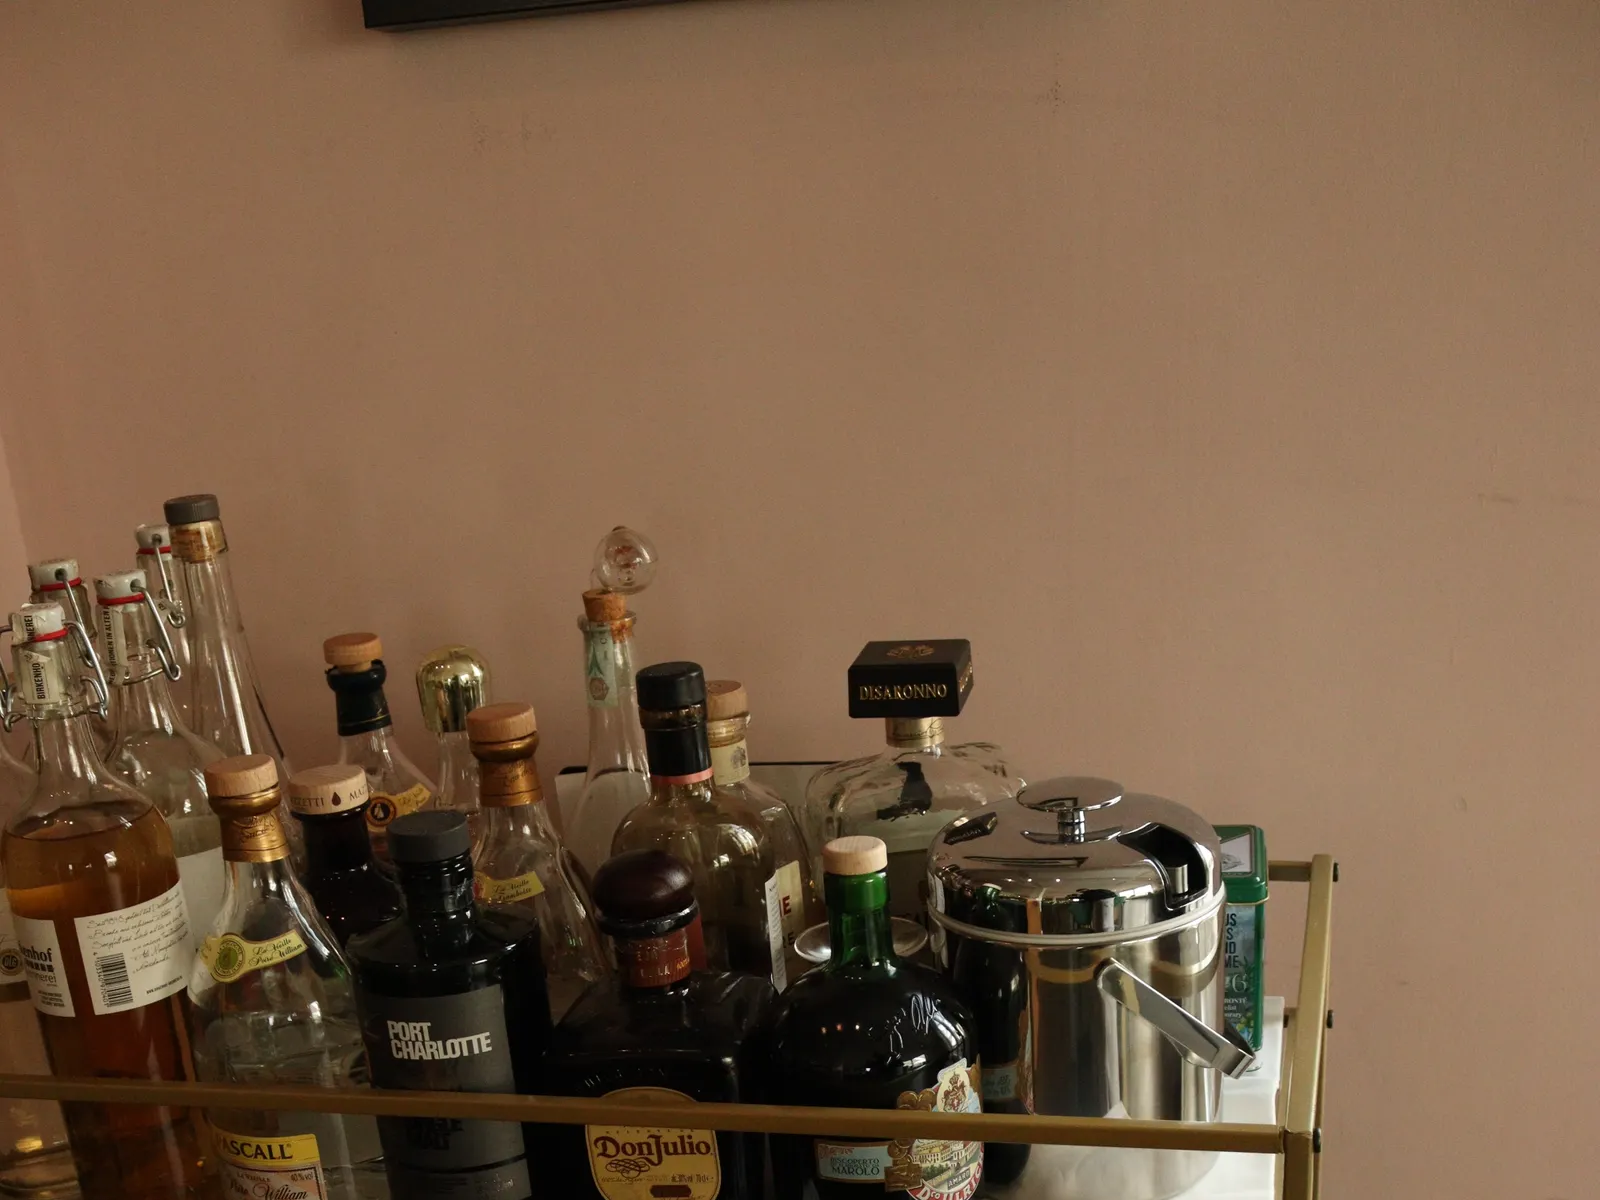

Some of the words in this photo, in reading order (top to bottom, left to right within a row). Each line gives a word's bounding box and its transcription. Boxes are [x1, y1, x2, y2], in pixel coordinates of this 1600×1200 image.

[103, 610, 112, 631] ALTEN
[859, 683, 948, 700] DISARONNO
[387, 1020, 431, 1041] PORT
[391, 1031, 493, 1061] CHARLOTTE
[831, 1166, 880, 1176] MAROLO
[949, 1167, 970, 1186] AMARO
[252, 1184, 308, 1200] William
